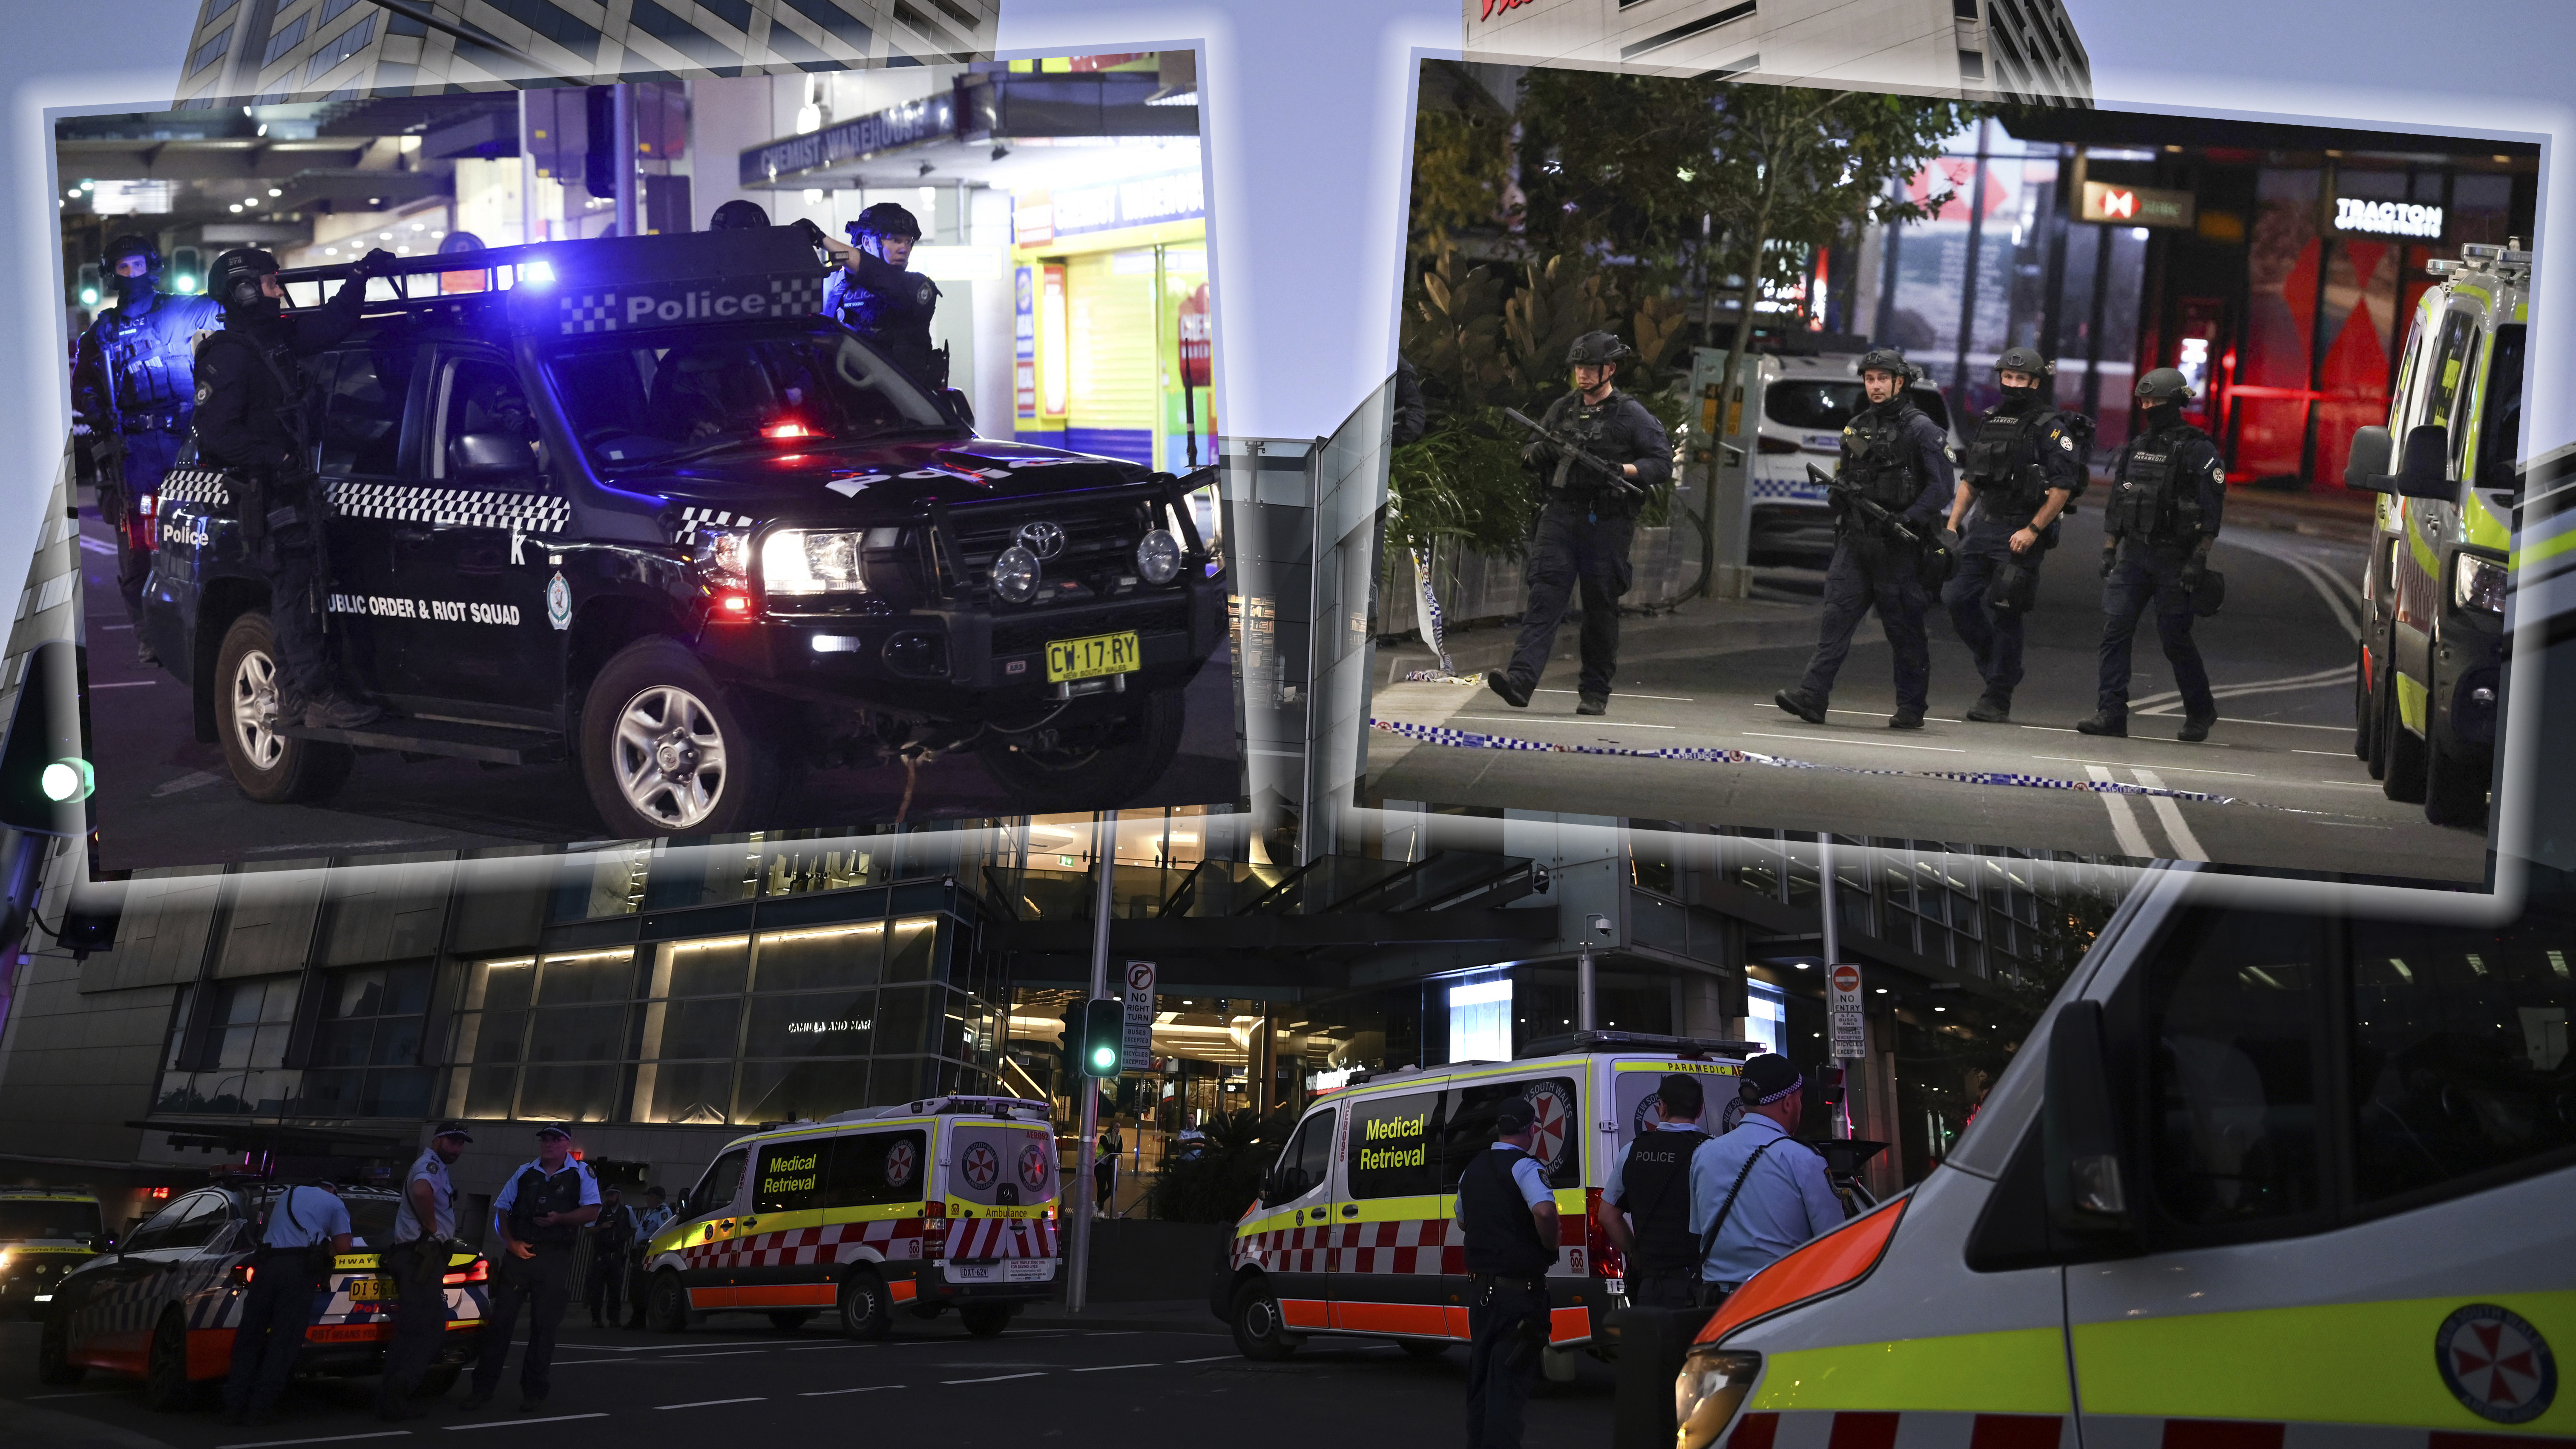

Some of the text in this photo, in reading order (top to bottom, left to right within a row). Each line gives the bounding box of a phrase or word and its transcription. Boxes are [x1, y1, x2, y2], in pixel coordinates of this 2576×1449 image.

[761, 135, 821, 175] CHEMIST
[627, 290, 766, 323] Police
[164, 524, 209, 546] Police
[511, 534, 527, 565] K
[328, 594, 520, 625] UBLIC ORDER & RIOT SQUAD
[1080, 669, 1102, 677] SOUTH
[1105, 664, 1127, 673] WALES
[1131, 993, 1147, 1002] NO
[1127, 1004, 1150, 1012] RIGHT
[788, 1021, 826, 1033] CAMILLA
[828, 1021, 848, 1031] AND
[1668, 1063, 1725, 1074] PARAMEDIC
[1530, 1081, 1573, 1118] SOUTH WALES
[1636, 1094, 1660, 1121] NEW SOU
[1724, 1098, 1743, 1123] NEW SOU
[1026, 1130, 1049, 1141] AER092
[1340, 1099, 1350, 1162] AER095
[1366, 1113, 1424, 1141] Medical
[963, 1148, 972, 1160] NEW
[986, 1144, 998, 1162] WALES
[1360, 1143, 1425, 1170] Retrieval
[1636, 1151, 1675, 1163] POLICE
[738, 1143, 752, 1190] AER092
[769, 1153, 817, 1173] Medical
[764, 1173, 816, 1194] Retrieval
[967, 1179, 995, 1190] AMBULANCE
[1022, 1180, 1044, 1191] AMBULANCE
[986, 1207, 1027, 1217] Ambulance
[909, 1245, 920, 1254] 000
[1570, 1257, 1584, 1268] 000
[331, 1329, 361, 1340] MEANS
